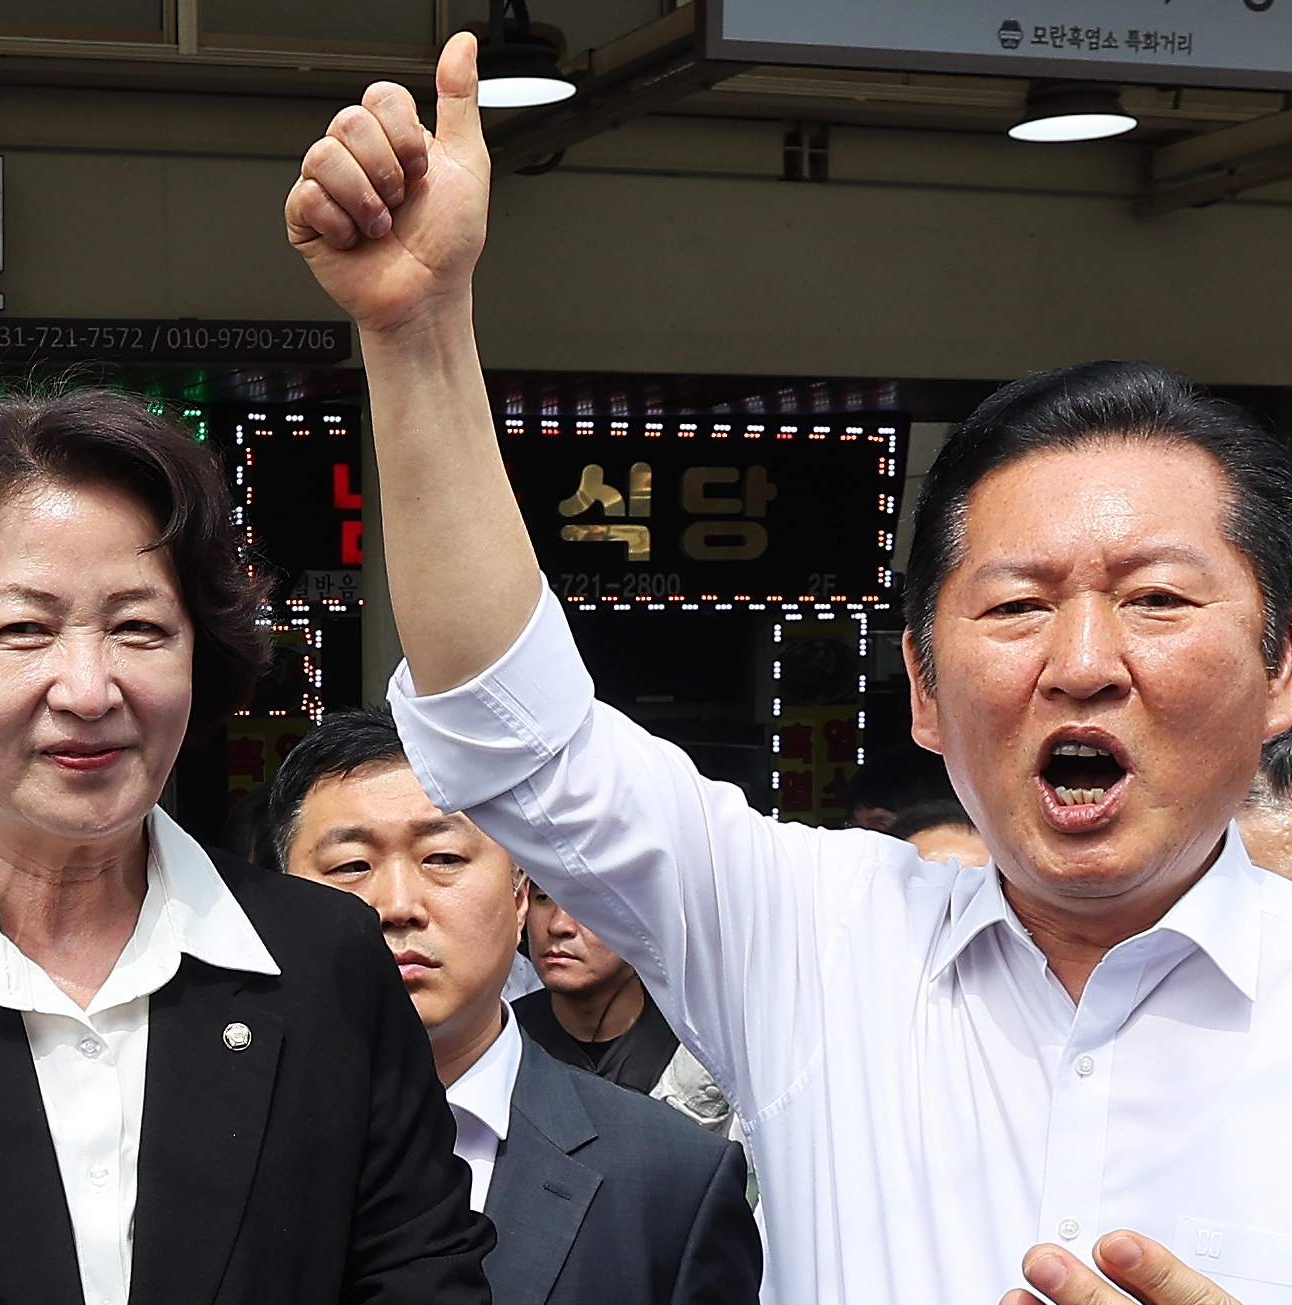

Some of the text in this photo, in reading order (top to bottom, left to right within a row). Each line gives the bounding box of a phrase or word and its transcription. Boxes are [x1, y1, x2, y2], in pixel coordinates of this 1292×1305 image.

[1030, 25, 1193, 55] 모란흑염소 특화거리
[167, 327, 335, 351] 010-9790-2706
[558, 461, 778, 562] 식당
